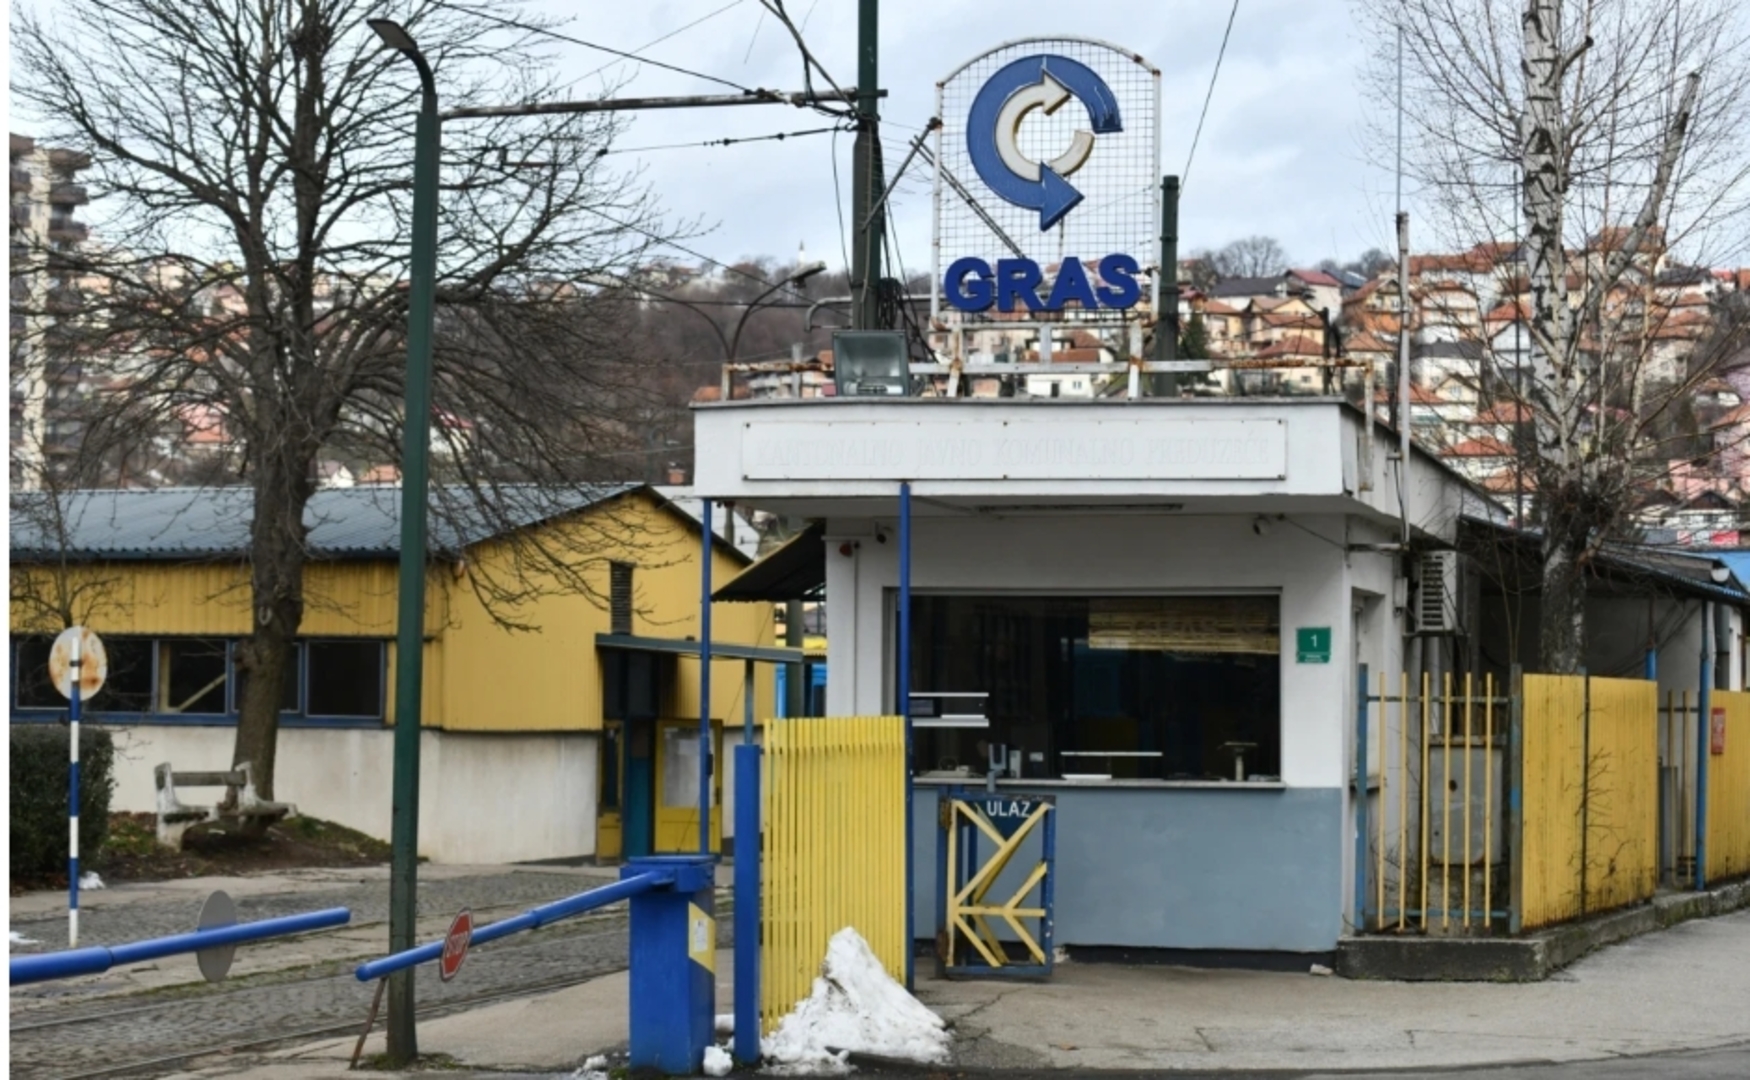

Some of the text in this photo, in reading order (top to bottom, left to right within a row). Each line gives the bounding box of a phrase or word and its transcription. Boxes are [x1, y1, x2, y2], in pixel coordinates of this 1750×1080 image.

[944, 253, 1141, 312] GRAS
[1310, 634, 1318, 648] 1
[986, 800, 1031, 817] ULAZ
[447, 930, 468, 957] STOP
